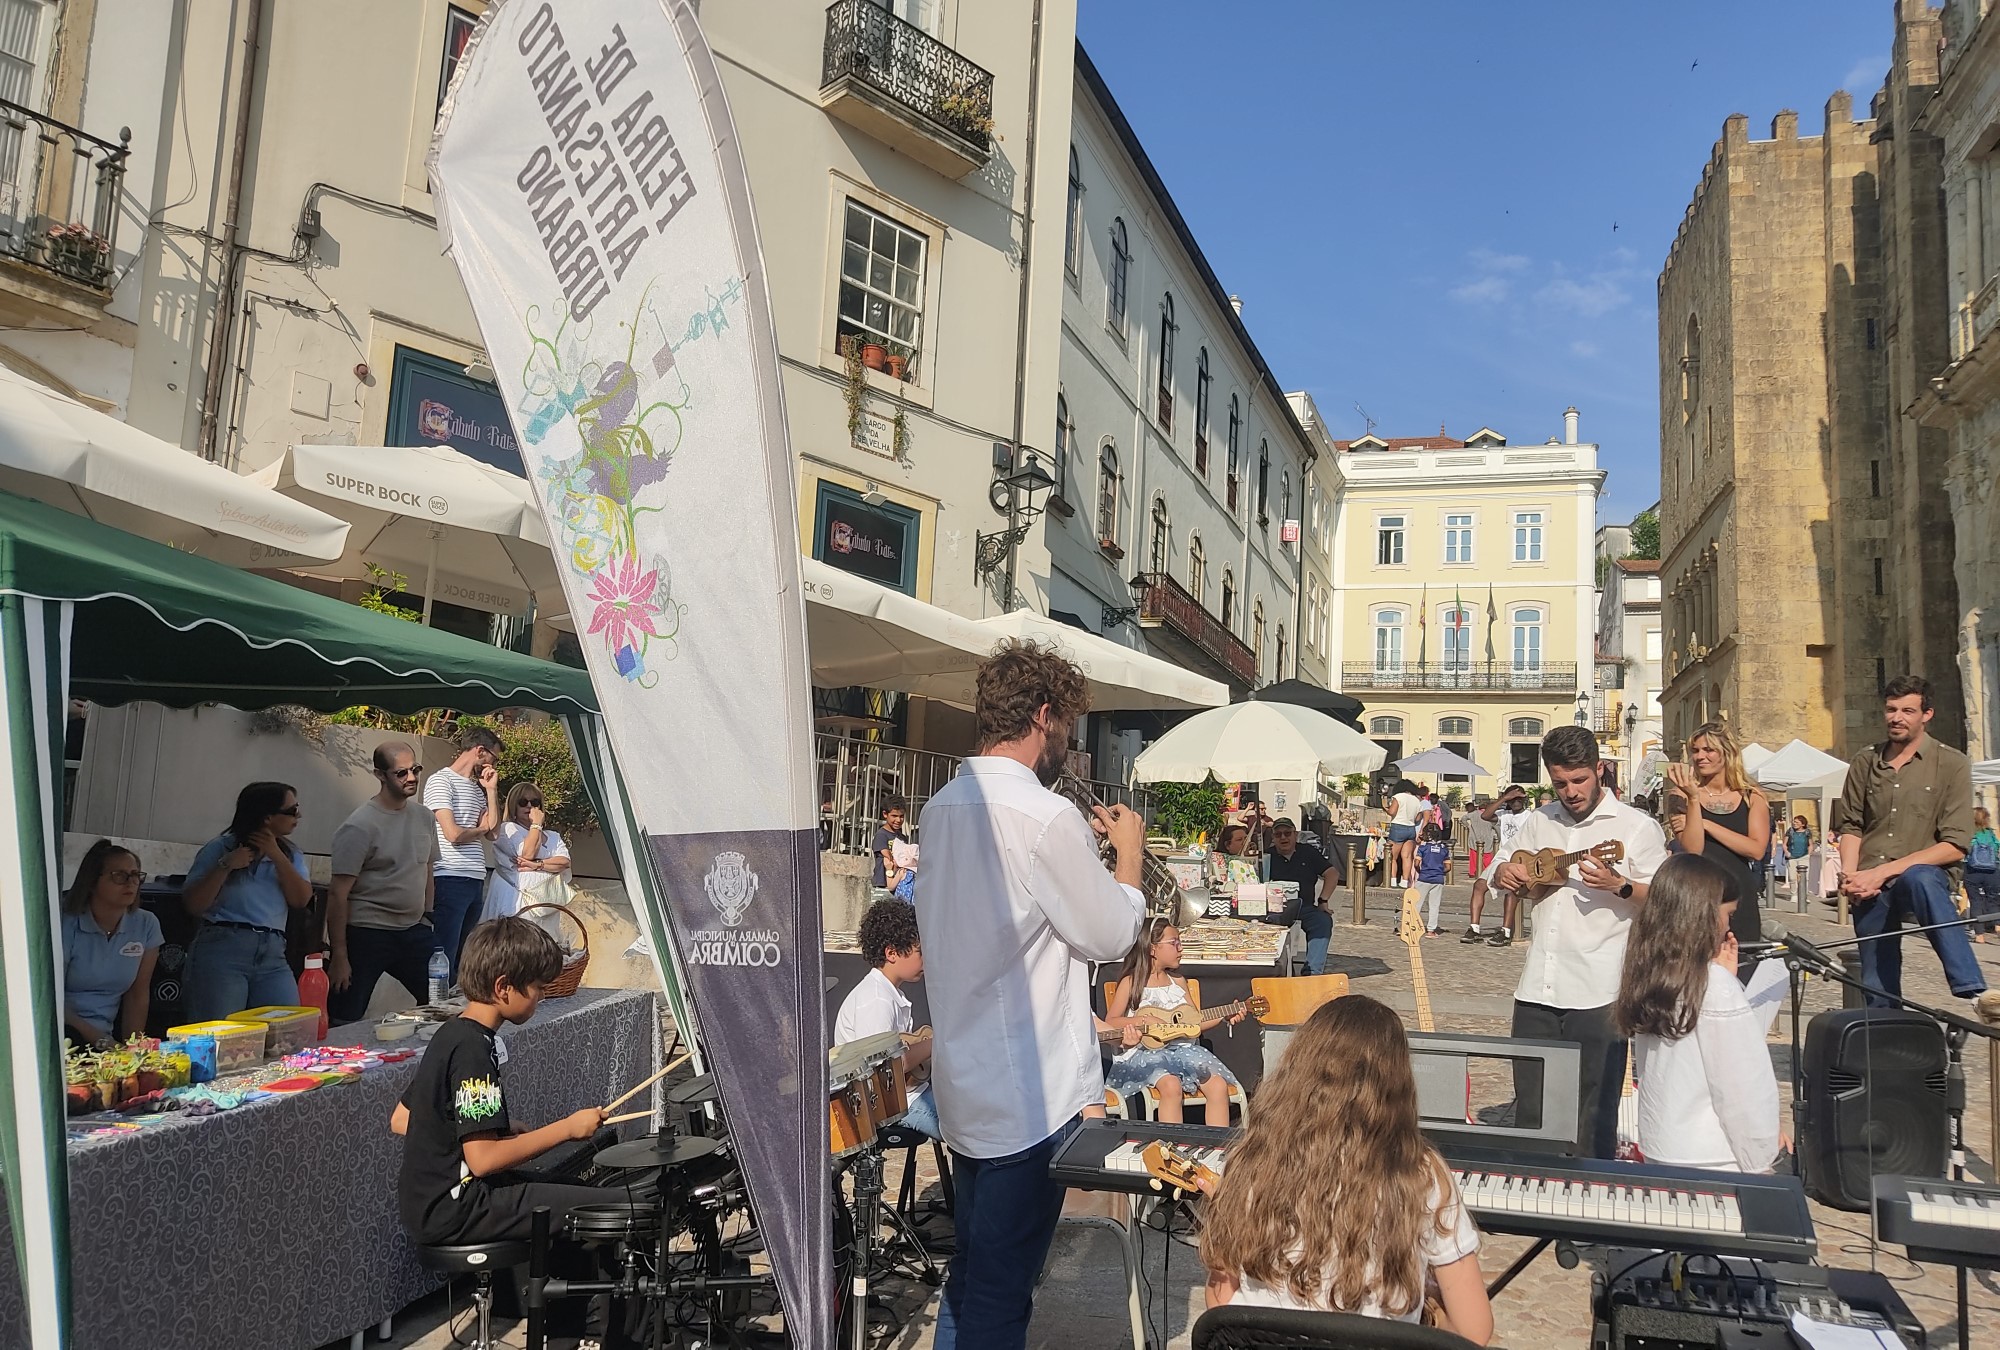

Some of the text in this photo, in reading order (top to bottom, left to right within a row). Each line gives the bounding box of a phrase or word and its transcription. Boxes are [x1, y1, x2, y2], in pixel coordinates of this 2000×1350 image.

[870, 429, 879, 439] DA
[868, 438, 891, 453] VELHA
[326, 472, 422, 508] SUPER BOCK
